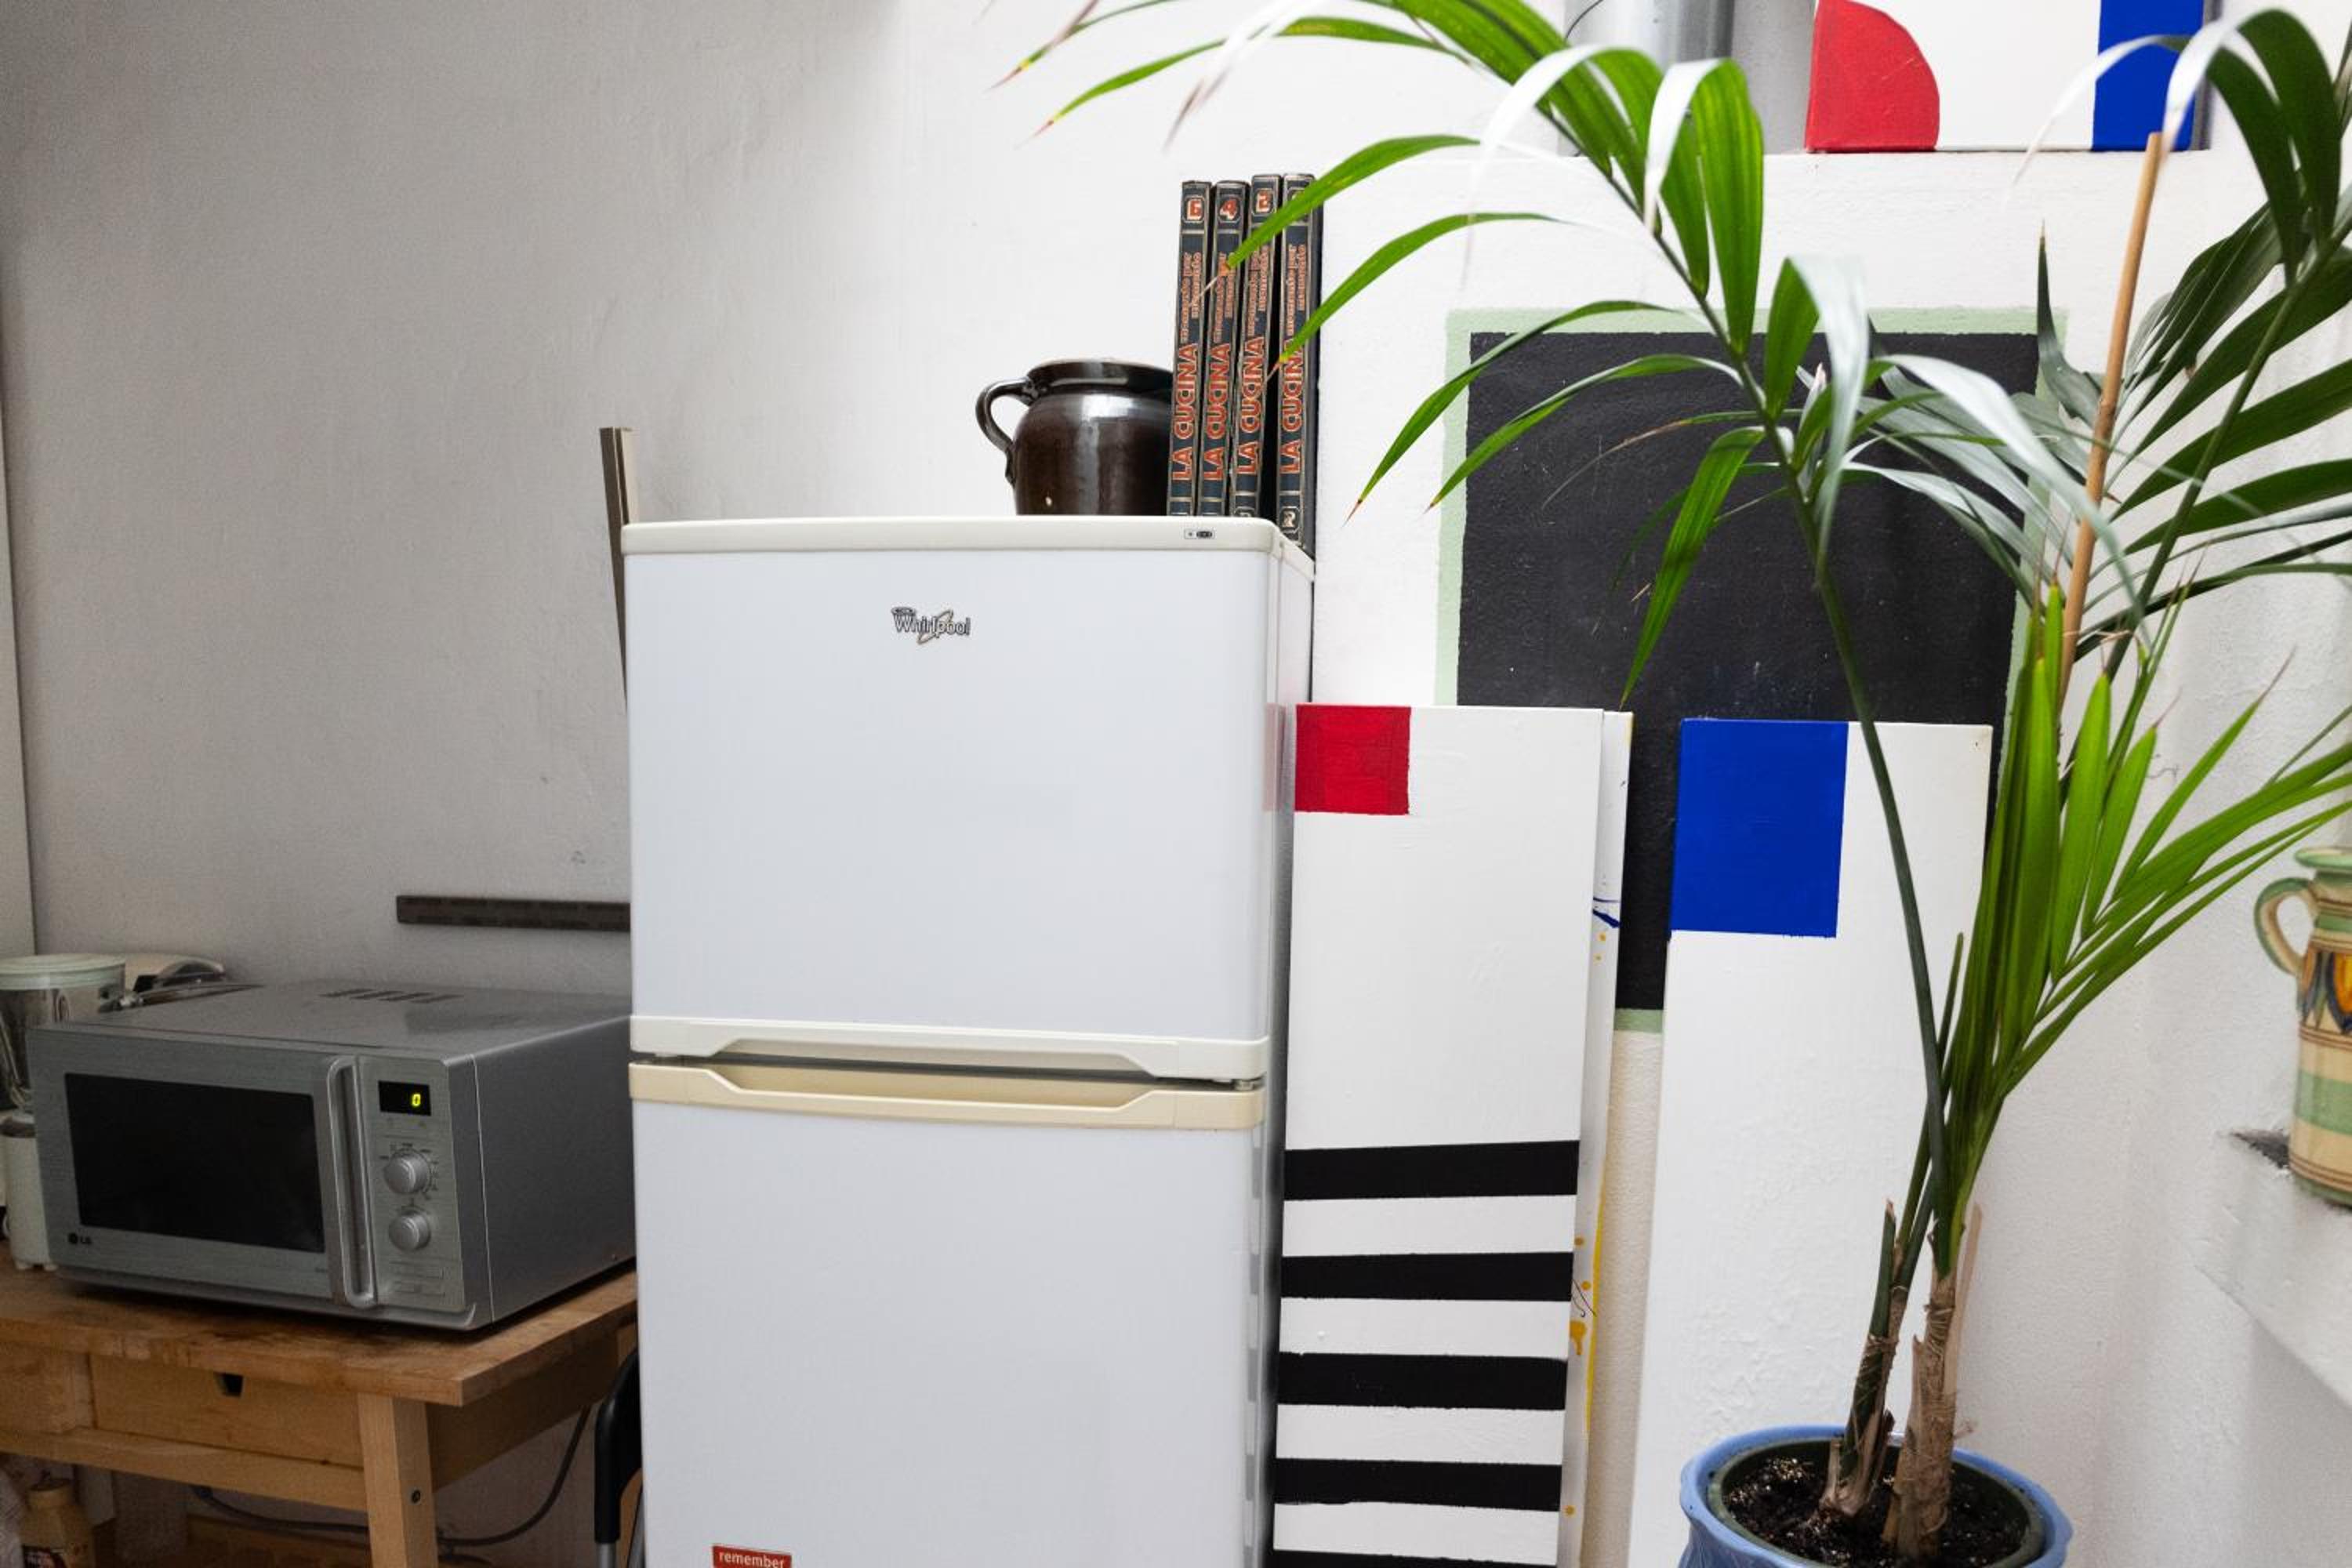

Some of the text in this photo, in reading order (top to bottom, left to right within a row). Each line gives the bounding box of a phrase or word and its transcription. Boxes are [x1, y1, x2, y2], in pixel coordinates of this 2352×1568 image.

[1219, 197, 1238, 220] 4
[1174, 343, 1198, 439] CUCINA
[1207, 343, 1230, 439] CUCINA
[1240, 336, 1265, 433] CUCINA
[1172, 447, 1192, 481] LA
[1204, 447, 1225, 481] LA
[1236, 441, 1260, 474] LA
[1279, 440, 1302, 474] LA
[891, 607, 971, 641] Whirlpool
[412, 1094, 422, 1106] 0
[718, 1551, 786, 1568] remember
